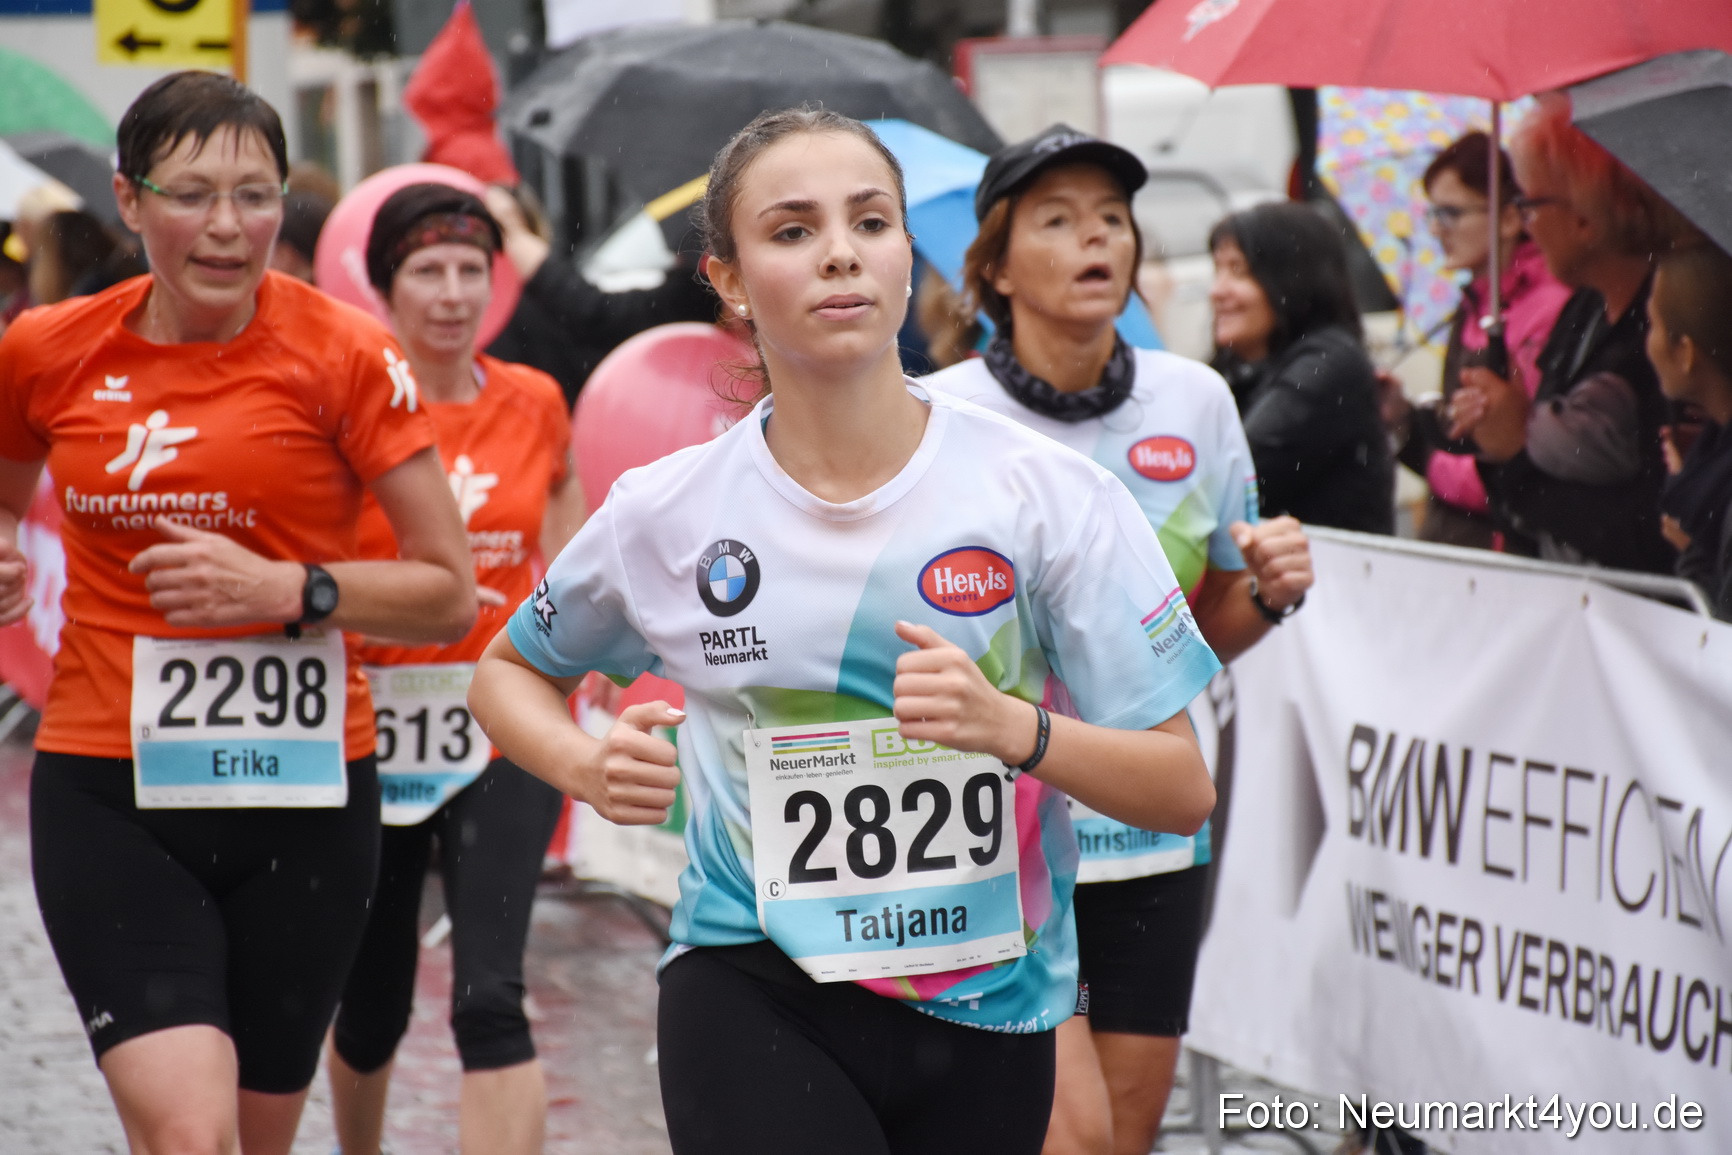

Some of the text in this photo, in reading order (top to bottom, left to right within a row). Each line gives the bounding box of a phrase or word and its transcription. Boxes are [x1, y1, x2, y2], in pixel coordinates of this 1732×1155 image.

[65, 486, 228, 513] funrunners
[699, 541, 754, 570] BMW
[933, 566, 1007, 597] Hervis
[942, 594, 978, 603] SPORTS
[699, 626, 766, 651] PARTL
[704, 648, 768, 666] Neumarkt
[158, 656, 327, 729] 2298
[375, 706, 471, 763] 613
[212, 748, 279, 777] Erika
[769, 753, 856, 771] NeuerMarkt
[873, 757, 914, 769] inspired
[917, 756, 929, 766] by
[931, 753, 961, 763] smart
[1347, 724, 1472, 866] BMW
[784, 772, 1002, 884] 2829
[1077, 828, 1161, 853] hristine
[836, 904, 967, 947] Tatjana
